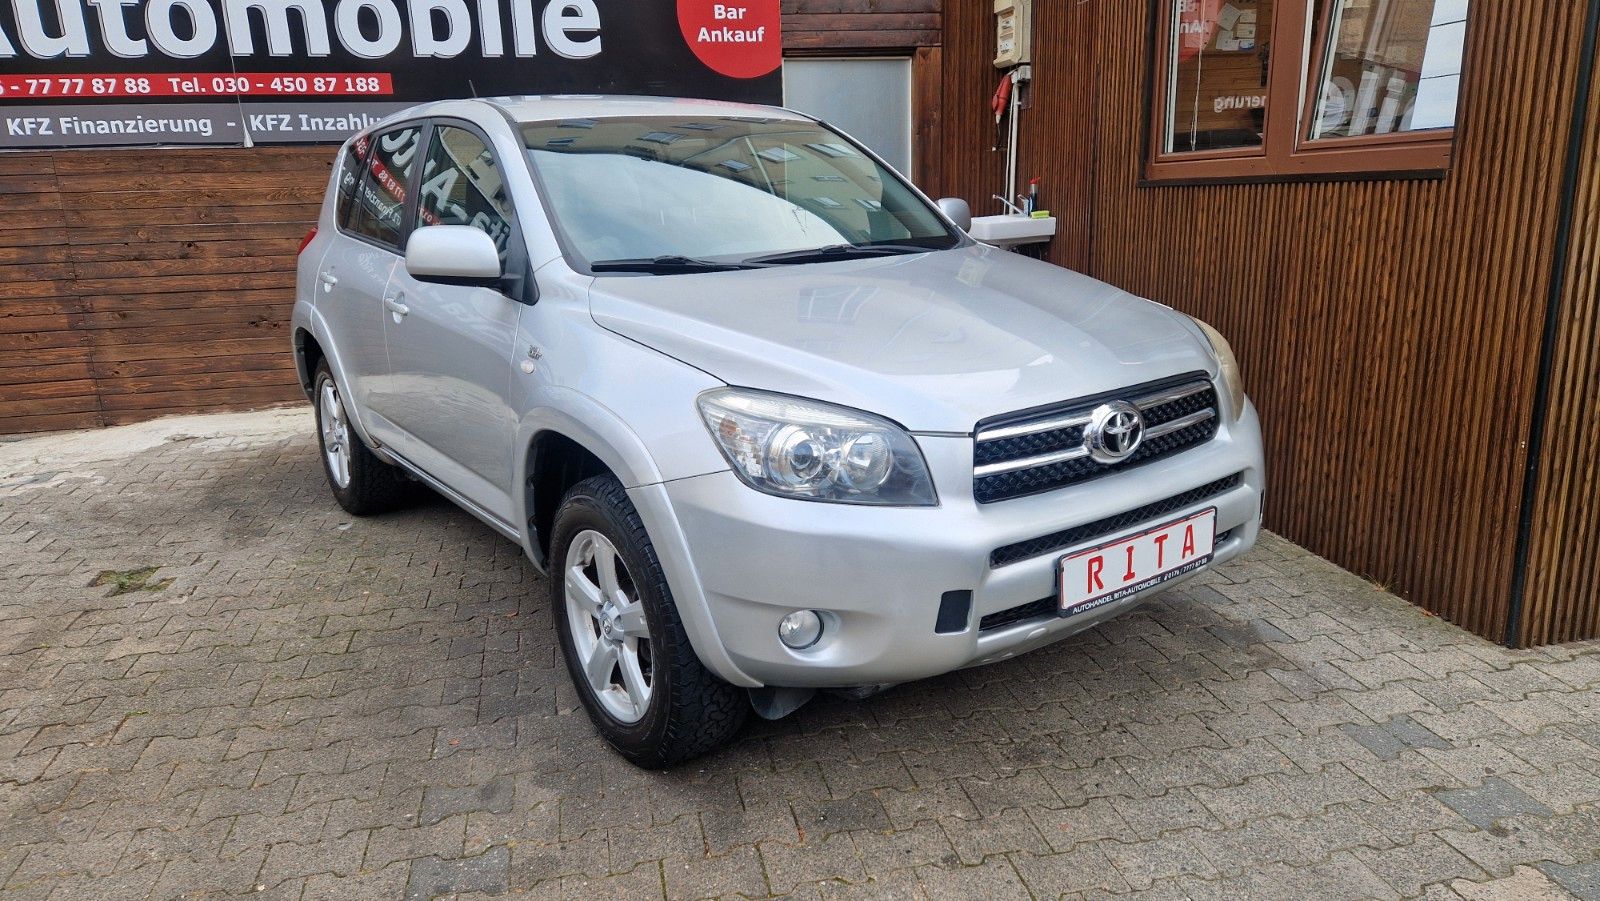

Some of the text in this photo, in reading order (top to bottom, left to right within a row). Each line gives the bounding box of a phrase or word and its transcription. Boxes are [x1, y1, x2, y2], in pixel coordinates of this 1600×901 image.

[713, 4, 747, 20] Bar
[0, 0, 602, 59] utomobile
[697, 26, 765, 43] Ankauf
[25, 78, 51, 95] 77
[58, 78, 84, 95] 77
[91, 77, 117, 94] 87
[124, 77, 151, 94] 88
[167, 77, 206, 93] Tel.
[212, 76, 250, 93] 030
[270, 77, 308, 93] 450
[313, 77, 337, 93] 87
[344, 77, 380, 92] 188
[6, 117, 54, 136] KFZ
[60, 115, 213, 137] Finanzierung
[250, 114, 293, 132] KFZ
[1087, 523, 1196, 594] RITA
[1073, 595, 1113, 614] AUTOHANDEL
[1114, 576, 1162, 600] RITA-AUTOMOBILE
